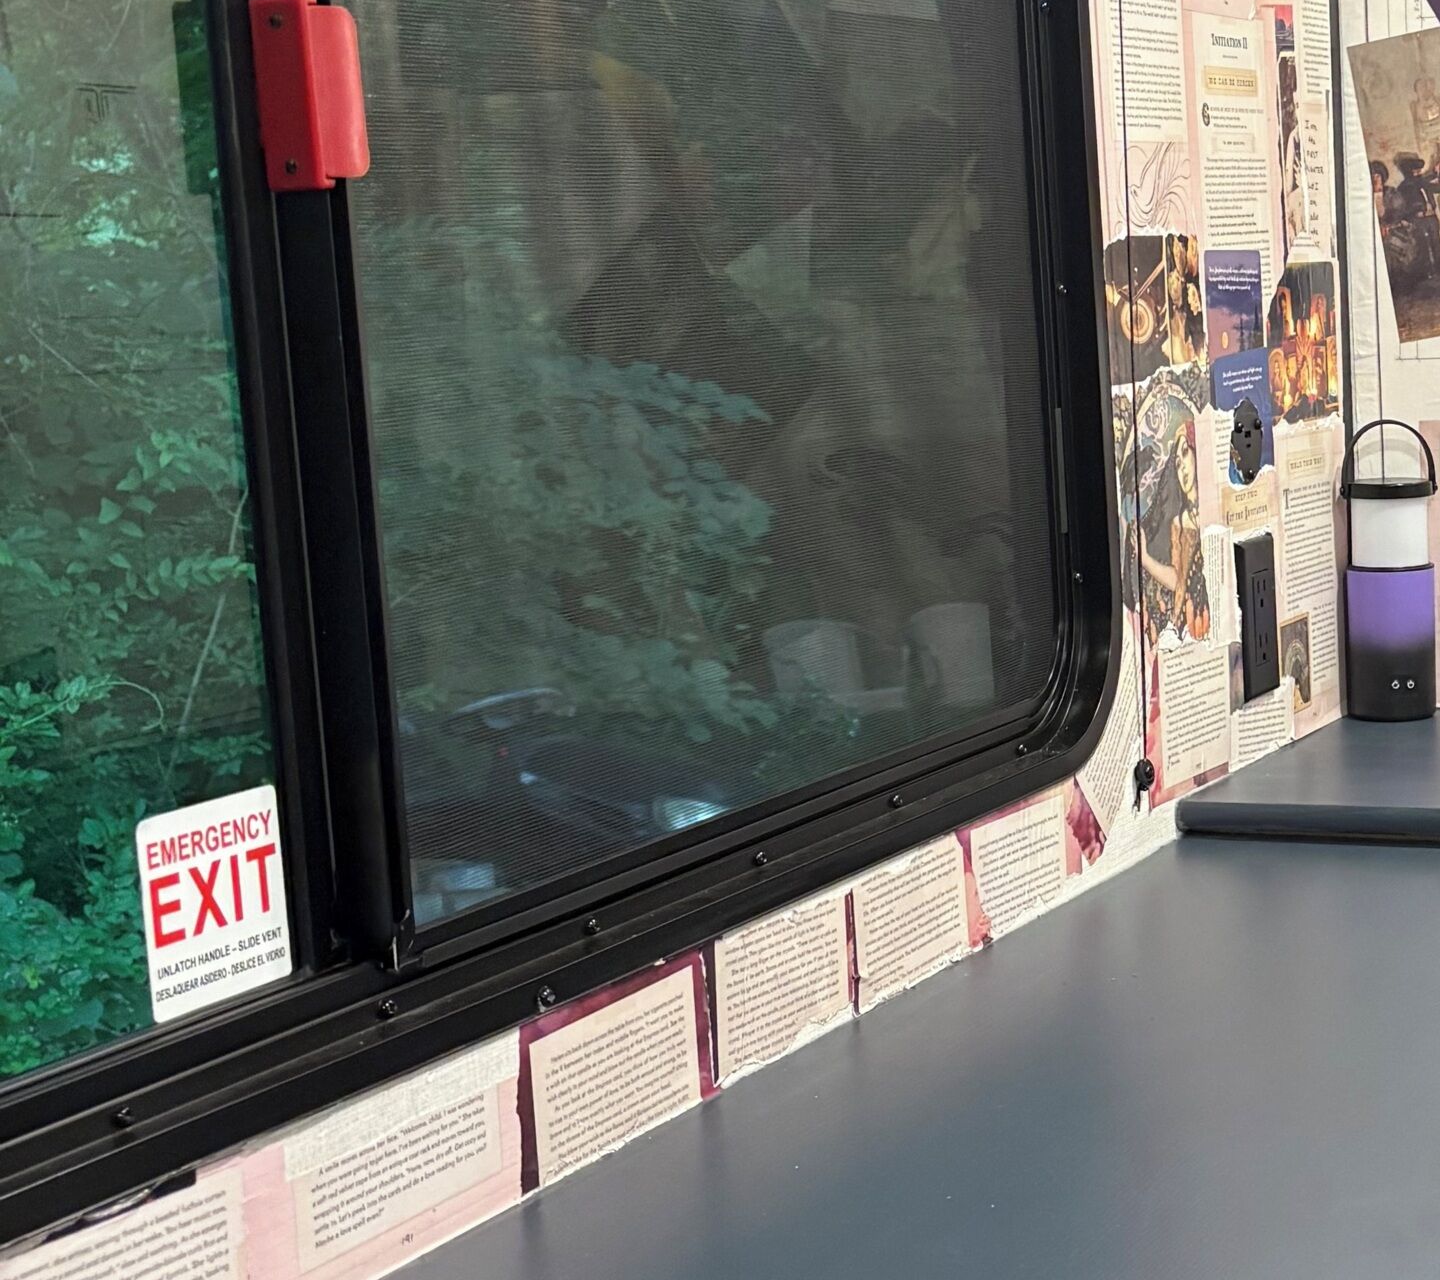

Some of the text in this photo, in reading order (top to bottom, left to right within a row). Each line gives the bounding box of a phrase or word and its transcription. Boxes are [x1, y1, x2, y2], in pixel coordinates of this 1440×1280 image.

[146, 809, 272, 870] EMERGENCY
[149, 842, 277, 949] EXIT
[155, 977, 199, 1003] DESLAQUEAR
[199, 968, 227, 988] ASIDERO
[230, 957, 256, 976] DESLICE
[266, 946, 286, 962] VIDRIO
[157, 956, 197, 981] UNLATCH
[197, 944, 231, 967] HANDLE
[238, 936, 261, 953] SLIDE
[261, 926, 282, 944] VENT
